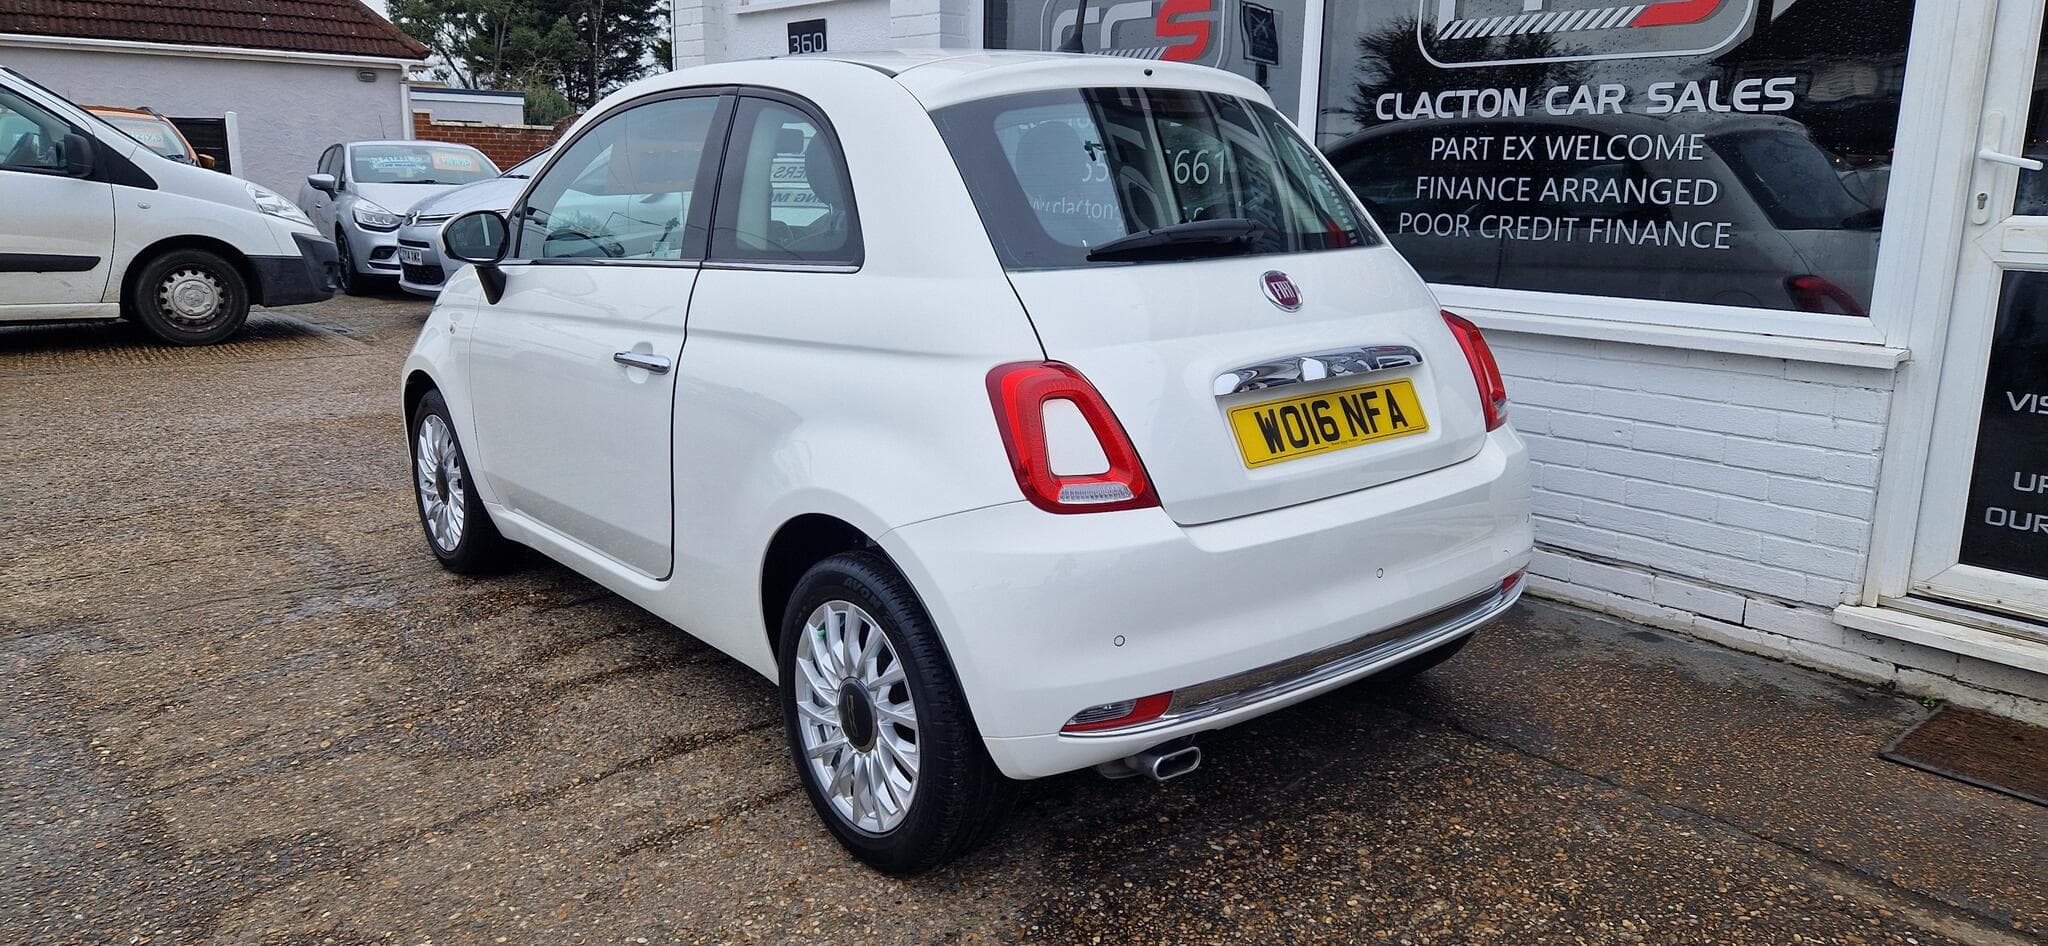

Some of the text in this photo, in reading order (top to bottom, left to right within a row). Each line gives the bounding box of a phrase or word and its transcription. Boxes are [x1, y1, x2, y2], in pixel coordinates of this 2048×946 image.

[790, 33, 824, 54] 360
[1375, 77, 1797, 121] CLACTON CAR SALES
[1431, 134, 1706, 161] PART EX WELCOME
[1416, 176, 1718, 206] FINANCE ARRANGED
[1399, 212, 1732, 250] POOR CREDIT FINANCE
[1270, 280, 1297, 300] FIAT
[1254, 388, 1409, 455] WO16 NFA
[1985, 506, 2048, 534] OUR
